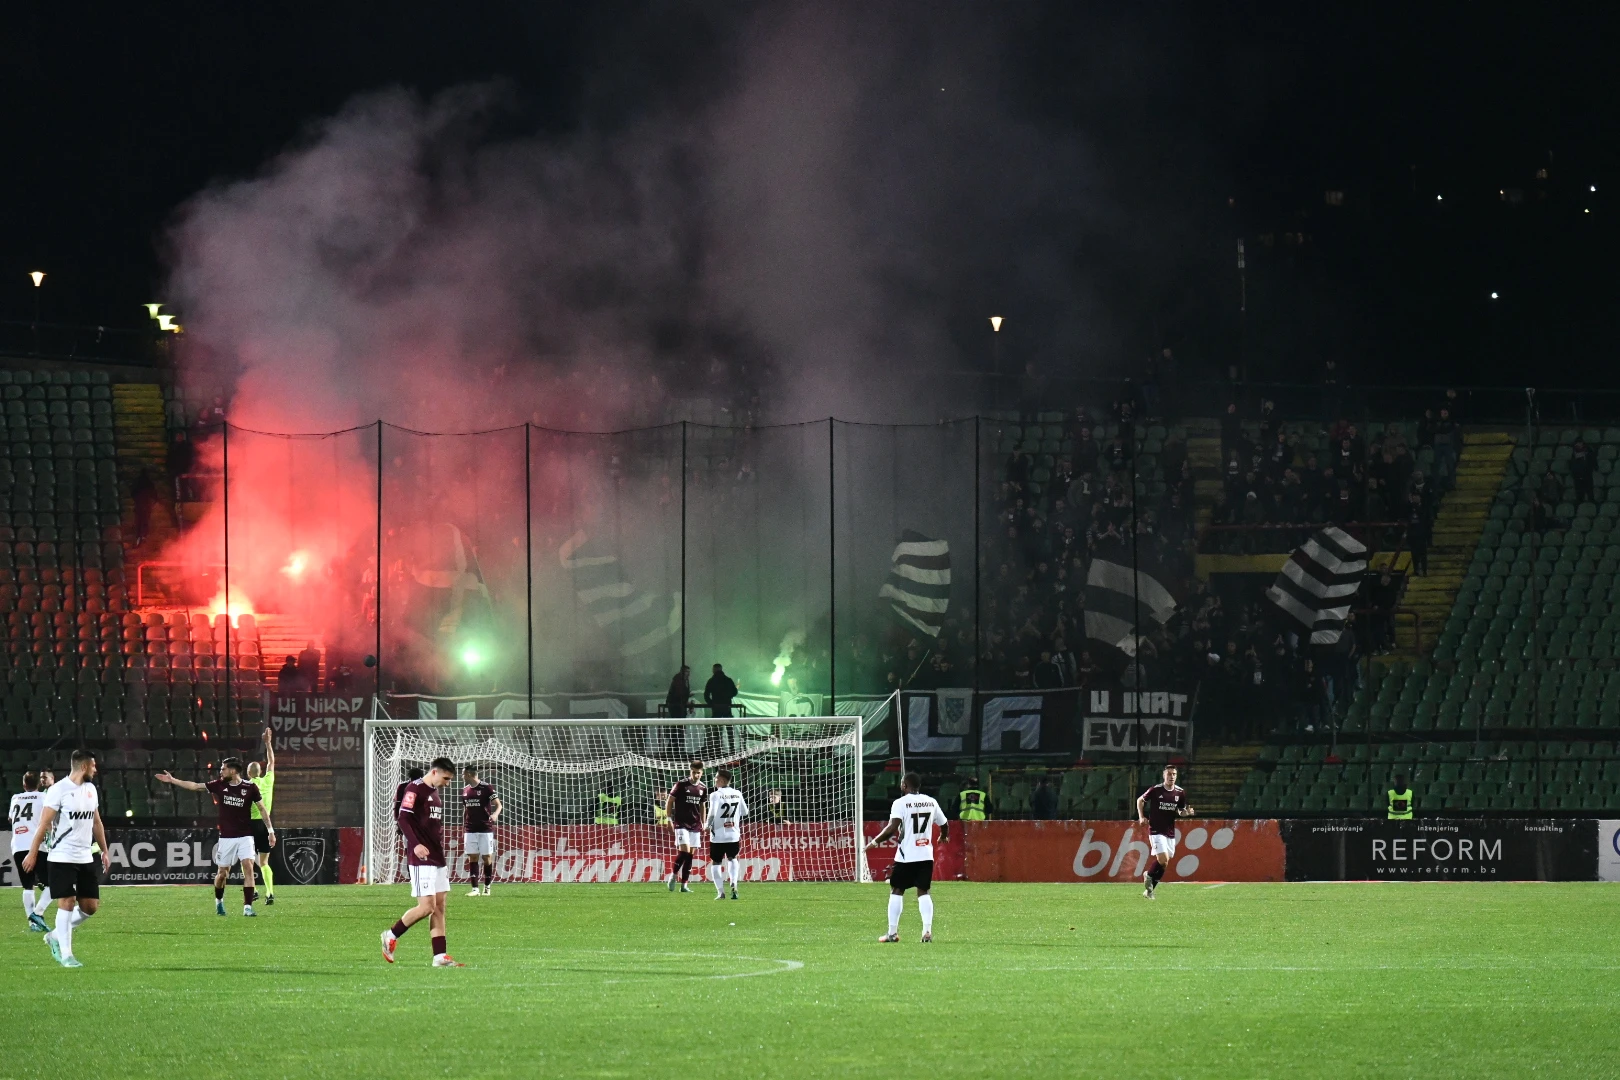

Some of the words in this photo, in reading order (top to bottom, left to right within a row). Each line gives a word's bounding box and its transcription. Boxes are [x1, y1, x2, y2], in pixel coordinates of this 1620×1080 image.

[1090, 690, 1109, 713] U
[1123, 691, 1188, 716] INAT
[12, 802, 34, 825] 24
[720, 801, 739, 819] 27
[910, 812, 932, 834] 17
[1311, 825, 1364, 833] projektovanje
[1417, 824, 1459, 833] inženjering
[1524, 825, 1564, 833] konsalting
[751, 836, 821, 850] TURKISH
[825, 836, 899, 850] AIRINES
[1372, 838, 1502, 861] REFORM
[110, 872, 162, 881] OFICIJELNO
[163, 872, 196, 880] VOZILO
[197, 871, 209, 880] FK
[210, 872, 259, 880] SRAJEO
[1376, 864, 1497, 874] www.reform.ba
